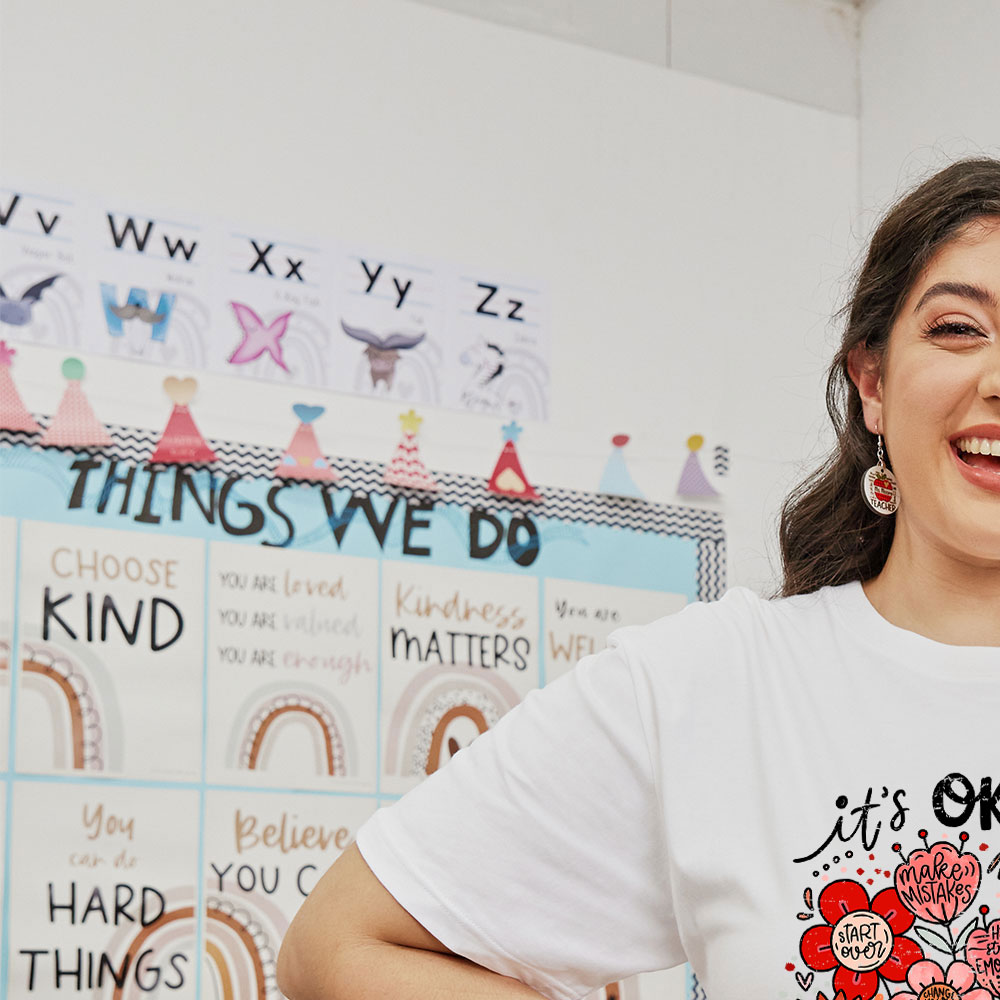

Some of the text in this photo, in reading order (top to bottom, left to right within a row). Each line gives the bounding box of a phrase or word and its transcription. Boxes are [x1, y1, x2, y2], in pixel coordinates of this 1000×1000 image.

[68, 459, 540, 567] THINGS WE DO
[51, 547, 178, 589] CHOOSE
[218, 568, 347, 601] YOU ARE loved
[42, 586, 184, 651] KIND
[217, 608, 247, 628] YOU
[251, 611, 276, 631] ARE
[395, 581, 527, 630] Kindness
[217, 646, 371, 685] YOU ARE enough
[391, 627, 531, 671] MATTERS
[82, 803, 136, 842] You
[234, 807, 353, 854] Believe
[793, 786, 910, 864] it's
[69, 852, 106, 869] can
[210, 862, 280, 894] YOU
[899, 852, 964, 885] make
[48, 881, 167, 928] HARD
[900, 878, 972, 906] MISTAKES
[838, 922, 880, 944] START
[841, 941, 886, 961] over
[18, 947, 188, 992] THINGS
